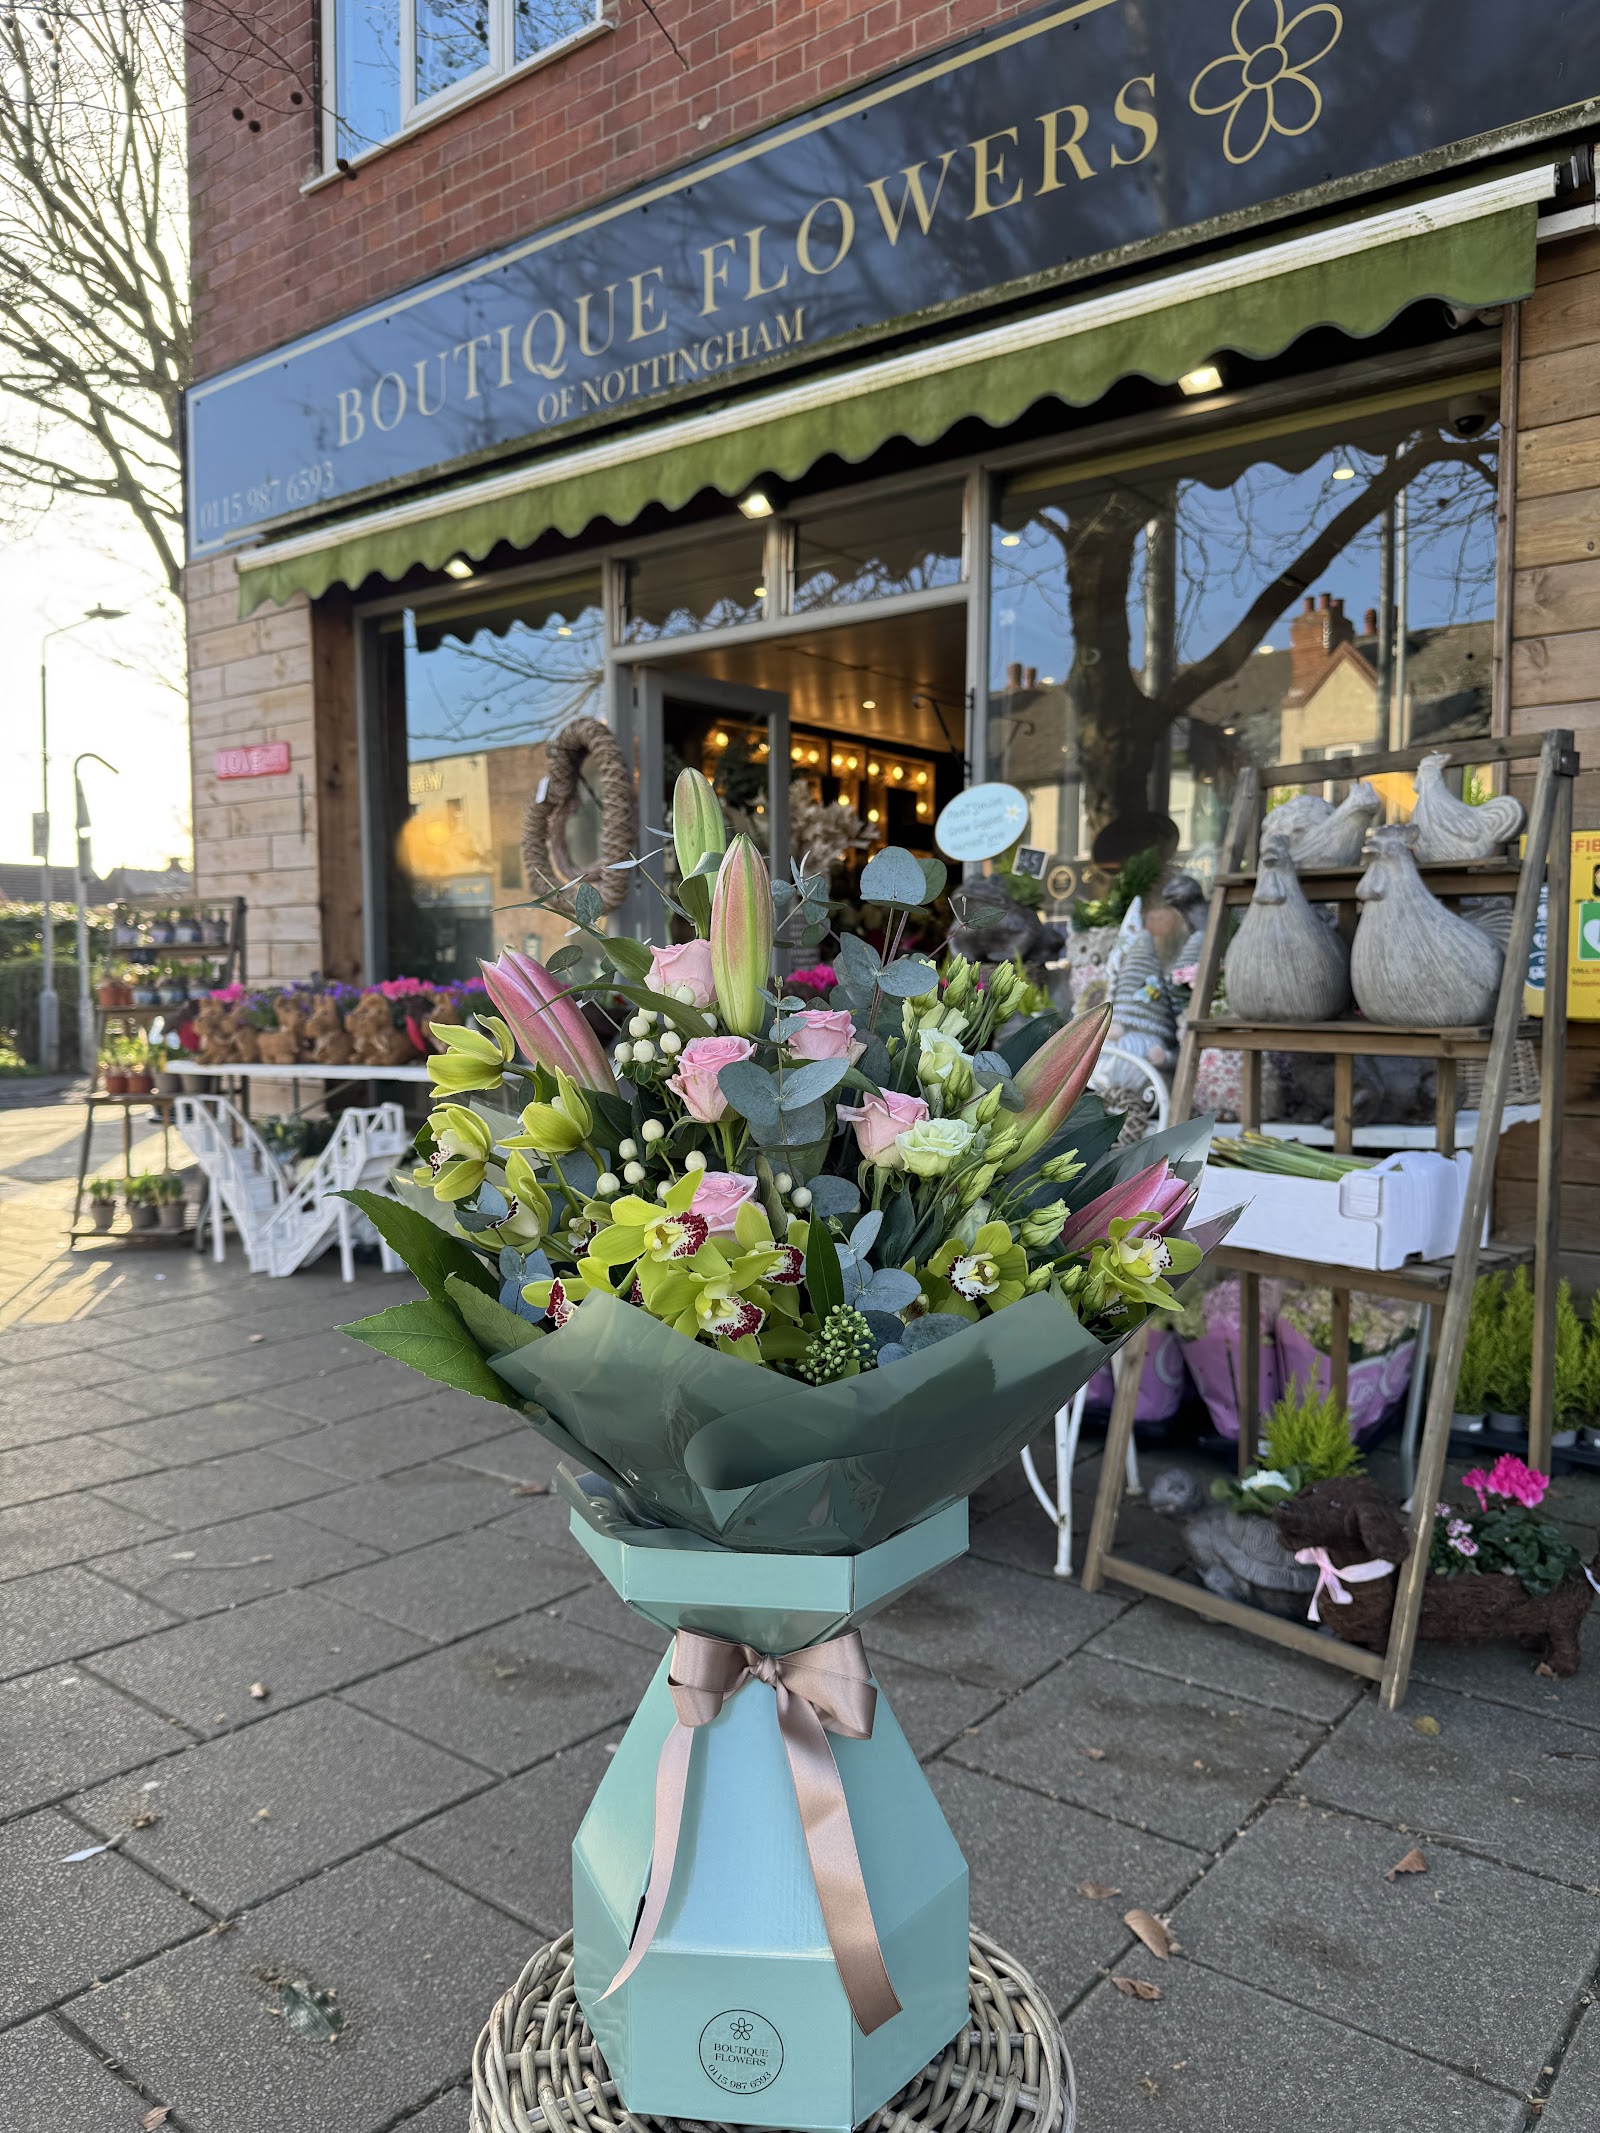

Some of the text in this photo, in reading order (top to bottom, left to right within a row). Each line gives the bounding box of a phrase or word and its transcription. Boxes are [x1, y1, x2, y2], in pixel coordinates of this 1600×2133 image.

[336, 73, 1159, 448] BOUTIQUE FLOWERS
[537, 306, 805, 424] OF NOTTINGHAM
[200, 460, 335, 530] 0115 987 6593
[714, 2043, 769, 2058] BOUTIQUE
[715, 2053, 767, 2067] FLOWERS
[708, 2064, 772, 2089] 0115 987 6593
